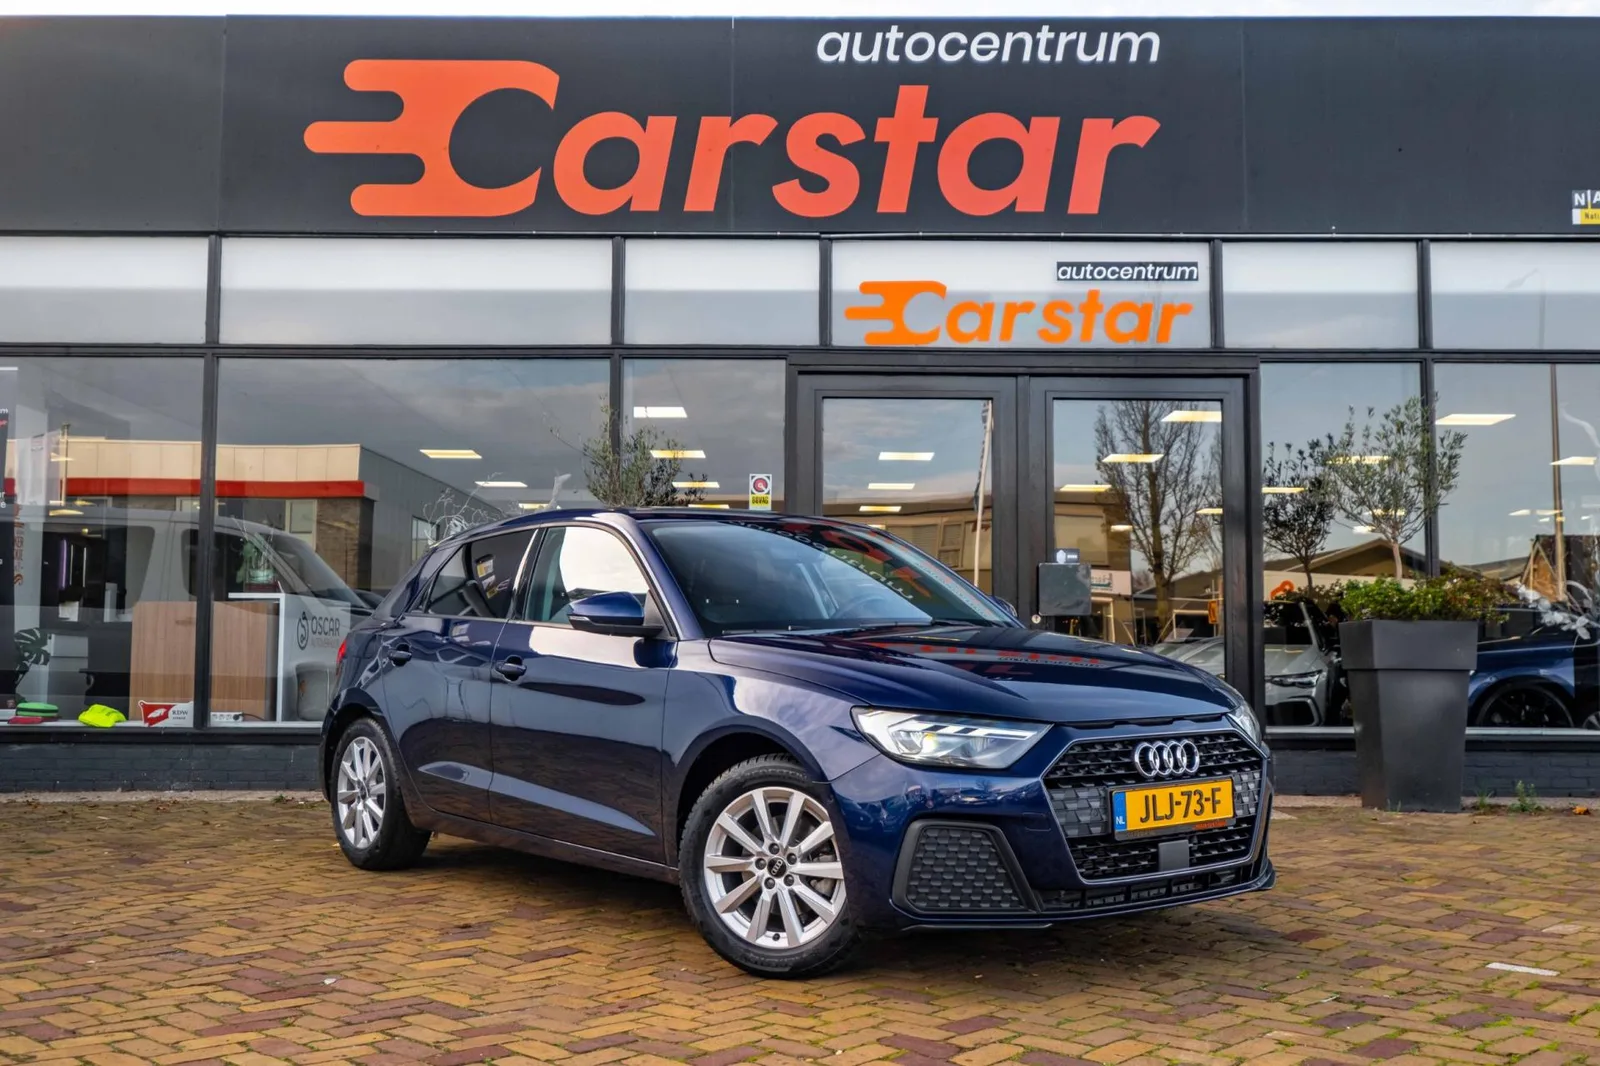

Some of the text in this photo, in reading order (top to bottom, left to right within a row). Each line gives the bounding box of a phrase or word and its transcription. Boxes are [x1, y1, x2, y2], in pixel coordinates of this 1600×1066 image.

[816, 25, 1162, 65] autocentrum
[304, 58, 1161, 218] Carstar
[1057, 263, 1198, 281] autocentrum
[844, 280, 1193, 345] Carstar
[311, 616, 340, 636] OSCAR
[1115, 816, 1125, 825] NL
[1140, 787, 1221, 823] JLJ-73-F
